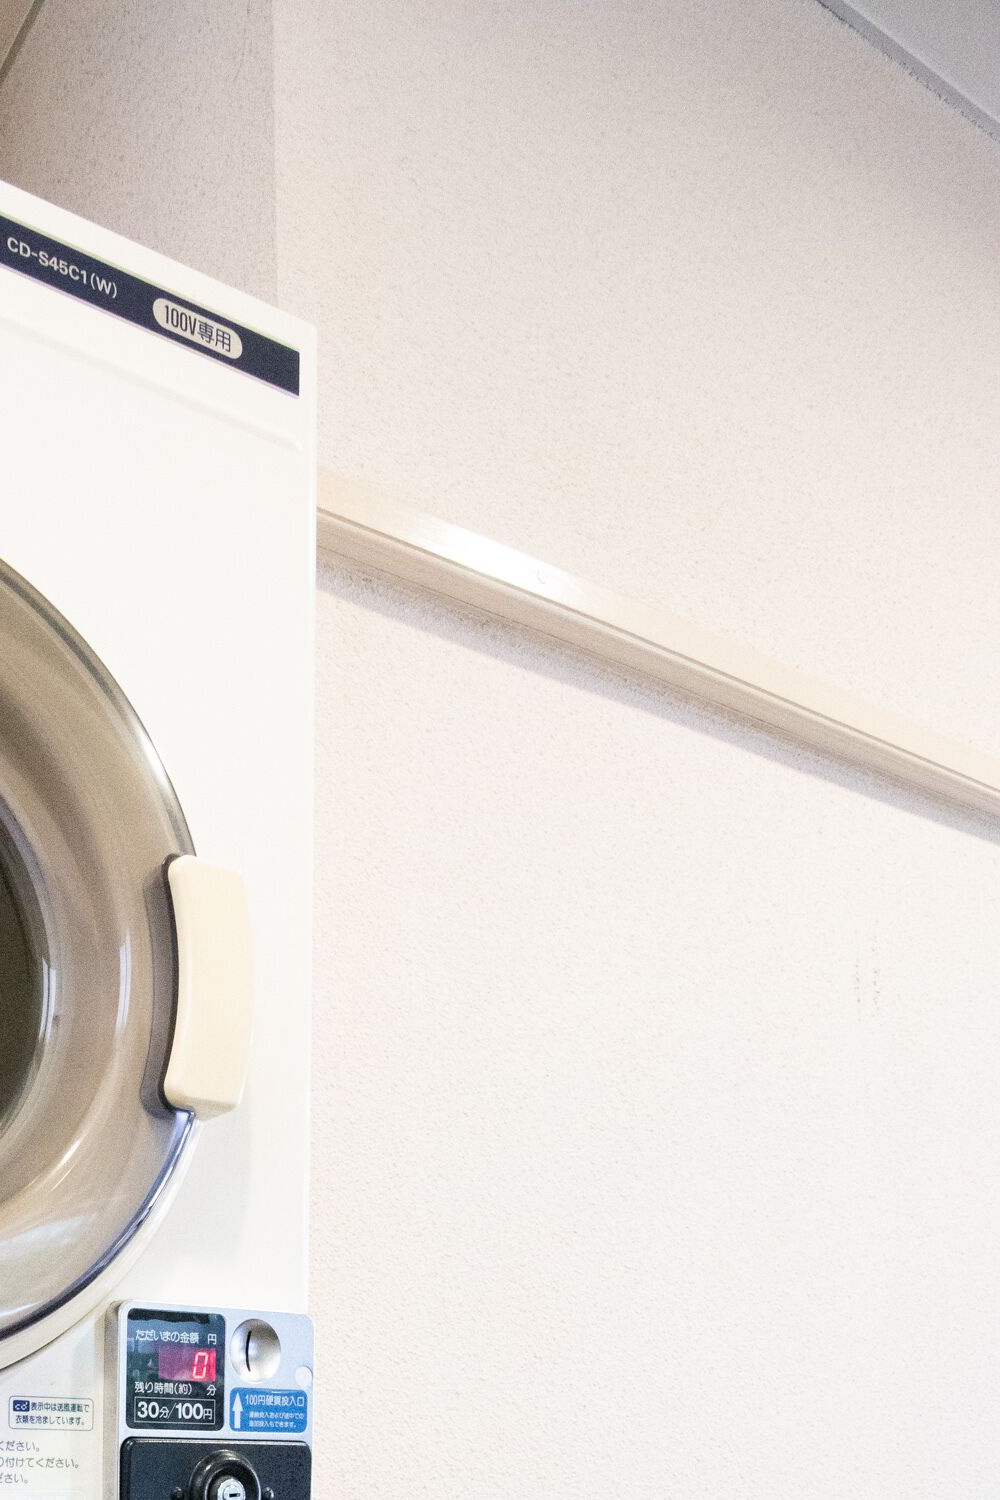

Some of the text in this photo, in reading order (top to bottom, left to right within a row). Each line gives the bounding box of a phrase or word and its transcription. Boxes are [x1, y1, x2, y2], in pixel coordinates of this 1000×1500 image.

[6, 235, 119, 300] CD-S45C1(W)
[162, 300, 233, 354] 100V専用
[135, 1329, 217, 1345] ただいまの金額 円
[192, 1351, 209, 1379] 0
[207, 1386, 216, 1395] 分
[245, 1395, 305, 1407] 100円硬貨投入口
[137, 1401, 213, 1420] 30分/100円
[16, 1415, 85, 1426] 衣類を冷ましています。
